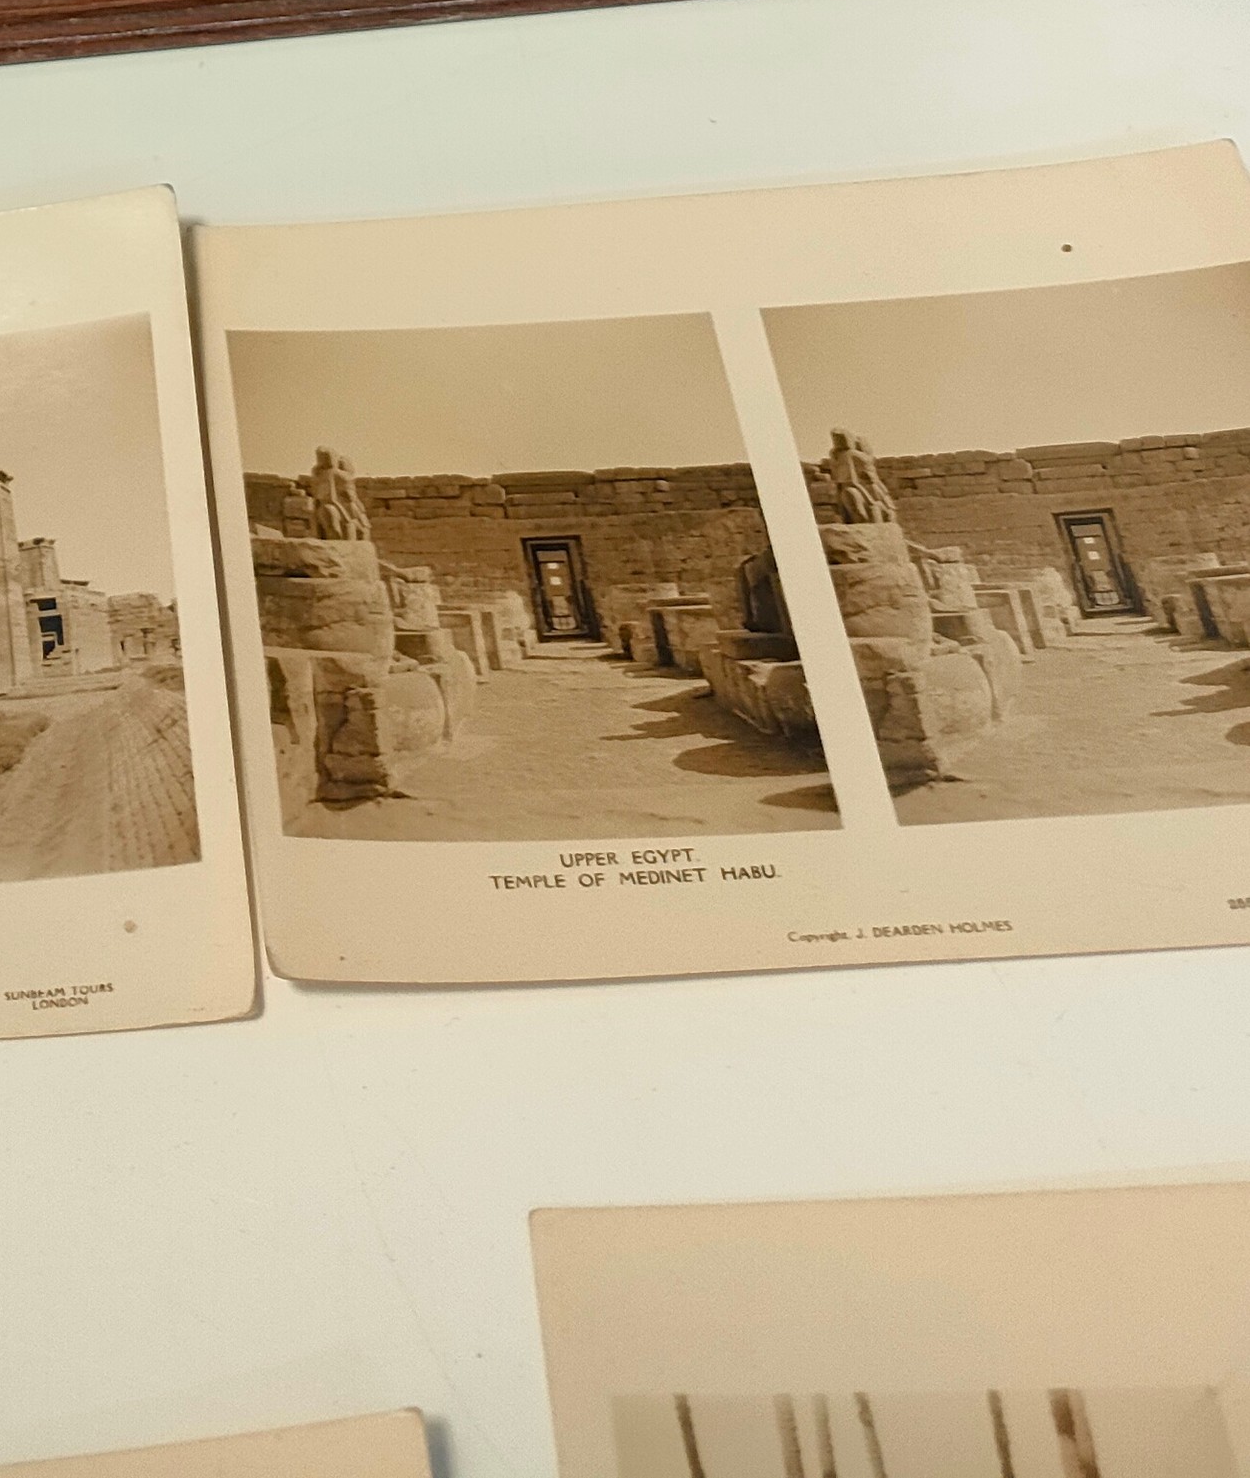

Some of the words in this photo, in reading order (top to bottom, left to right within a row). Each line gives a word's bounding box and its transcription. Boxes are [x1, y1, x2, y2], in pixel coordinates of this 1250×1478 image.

[559, 851, 619, 868] UPPER
[488, 874, 566, 890] TEMPLE
[578, 872, 607, 888] OF
[619, 867, 707, 886] MEDINET
[872, 923, 943, 938] DEARDEN
[948, 920, 1013, 934] HOLMES
[3, 987, 66, 1001] SUNBEAM
[71, 982, 114, 996] TOURS
[32, 997, 89, 1011] LONDON
